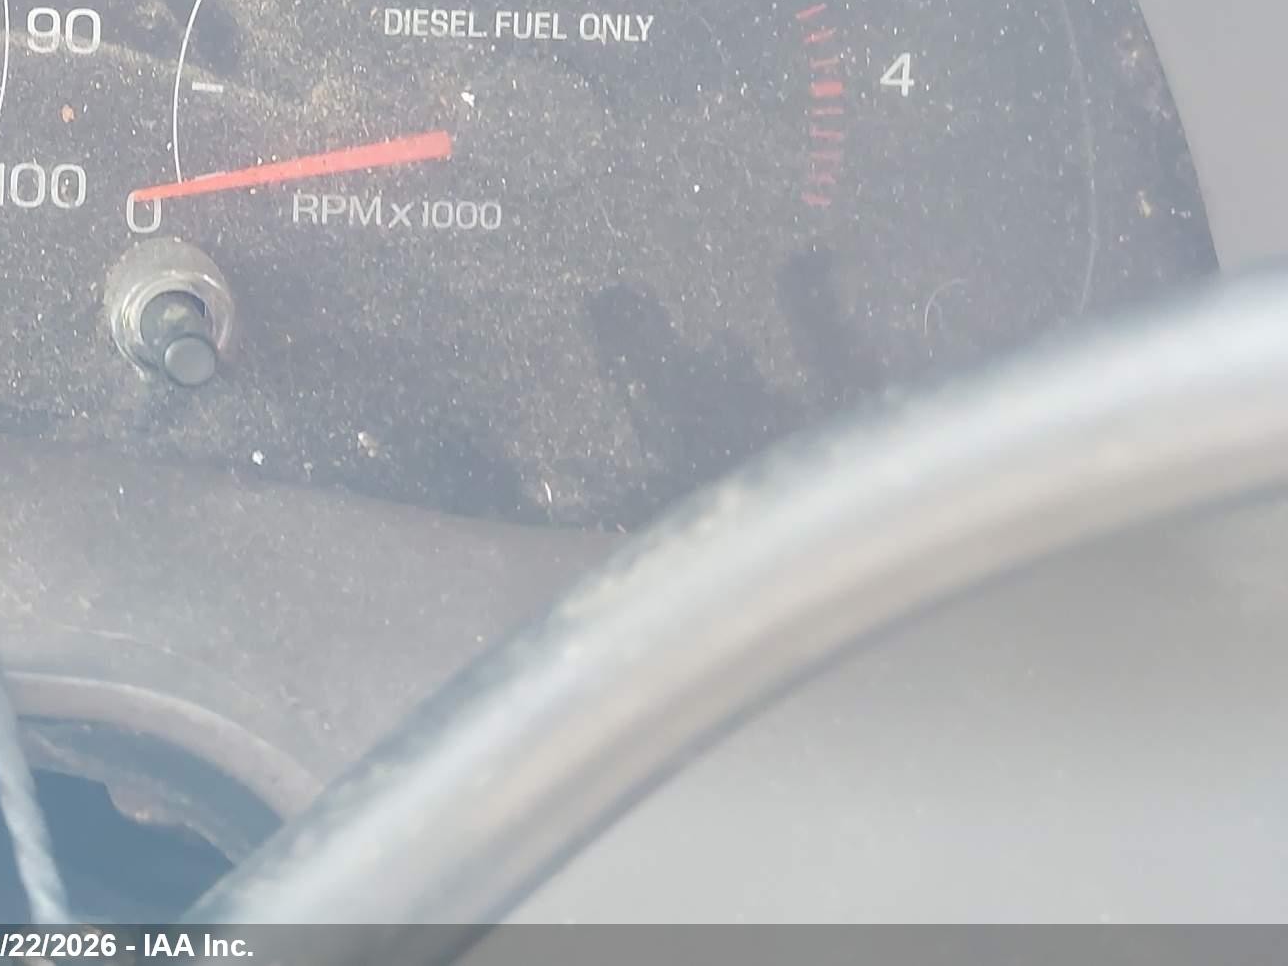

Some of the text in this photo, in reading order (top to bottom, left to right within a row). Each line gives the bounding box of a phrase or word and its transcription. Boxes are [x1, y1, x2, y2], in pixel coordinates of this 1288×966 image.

[27, 7, 101, 55] 90
[384, 8, 654, 42] DIESEL FUEL ONLY
[879, 52, 914, 97] 4
[126, 192, 161, 233] 0
[292, 193, 382, 226] RPM
[421, 200, 502, 231] 1000
